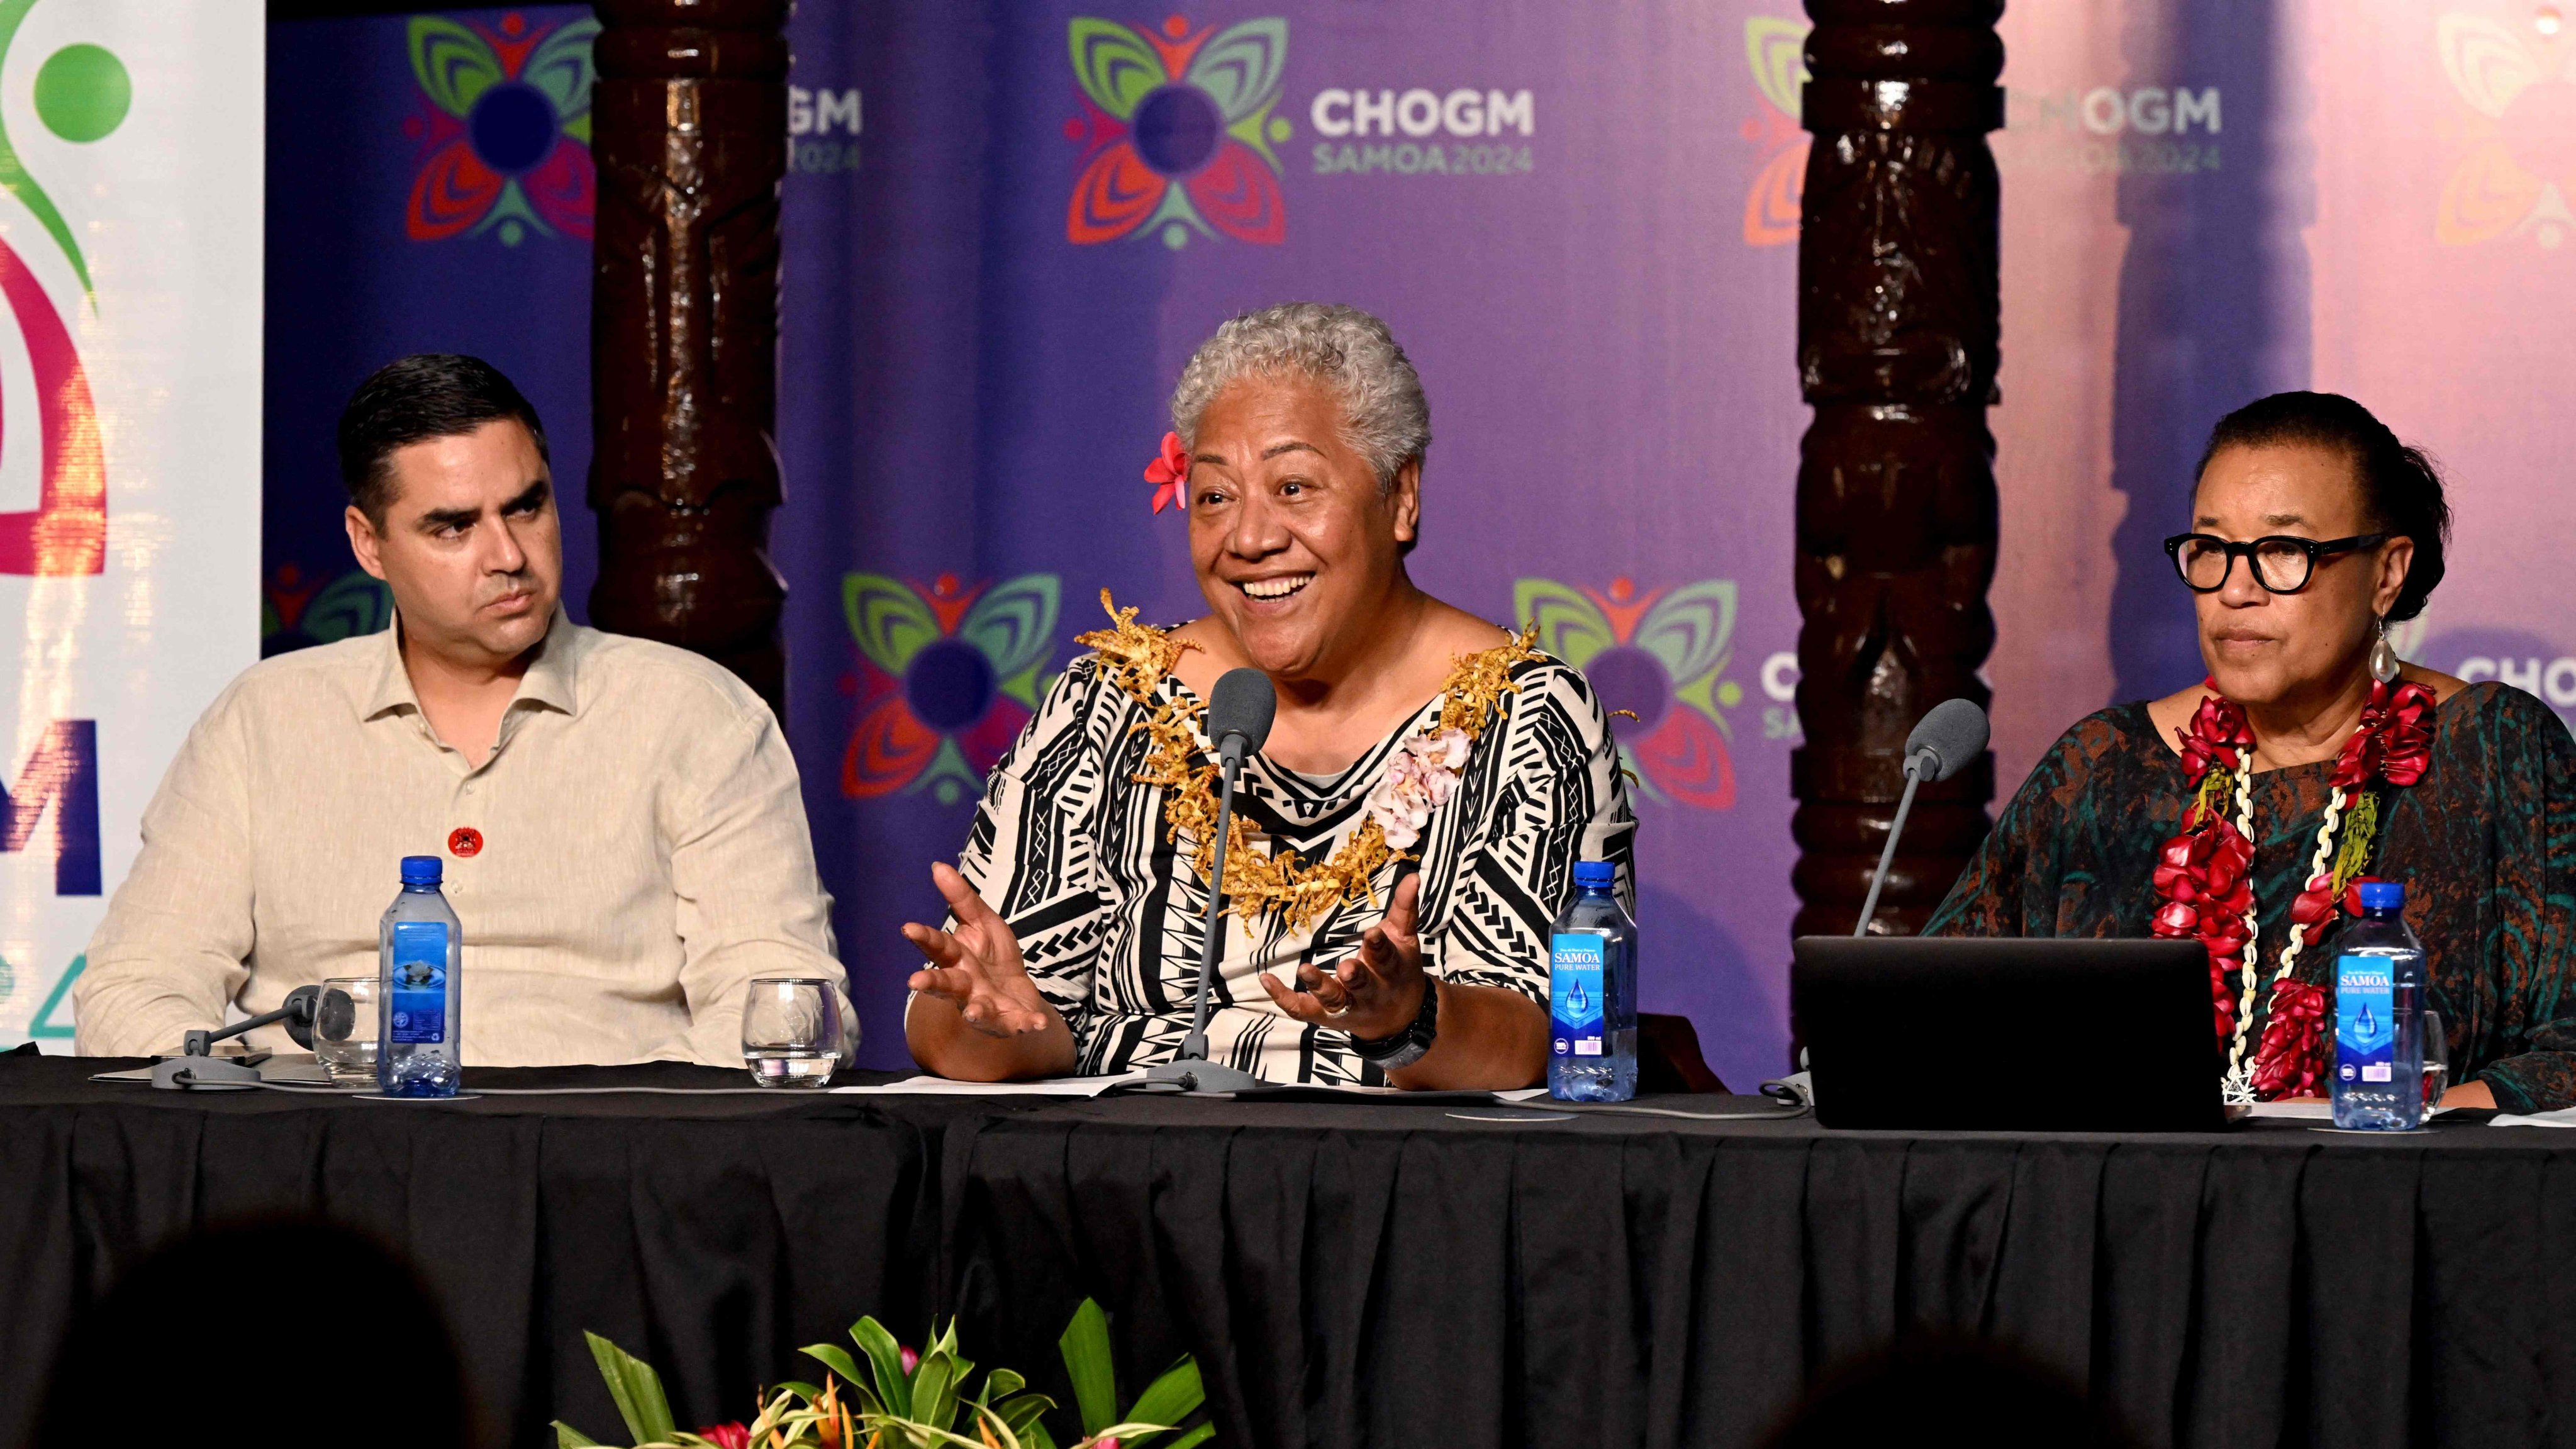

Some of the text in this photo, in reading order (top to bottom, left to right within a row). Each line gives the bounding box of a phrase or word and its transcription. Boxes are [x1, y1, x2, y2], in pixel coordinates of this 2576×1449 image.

[1311, 87, 1536, 137] CHOGM
[790, 143, 861, 173] 024
[1554, 953, 1600, 963] SAMOA
[2340, 975, 2390, 987] SAMOA
